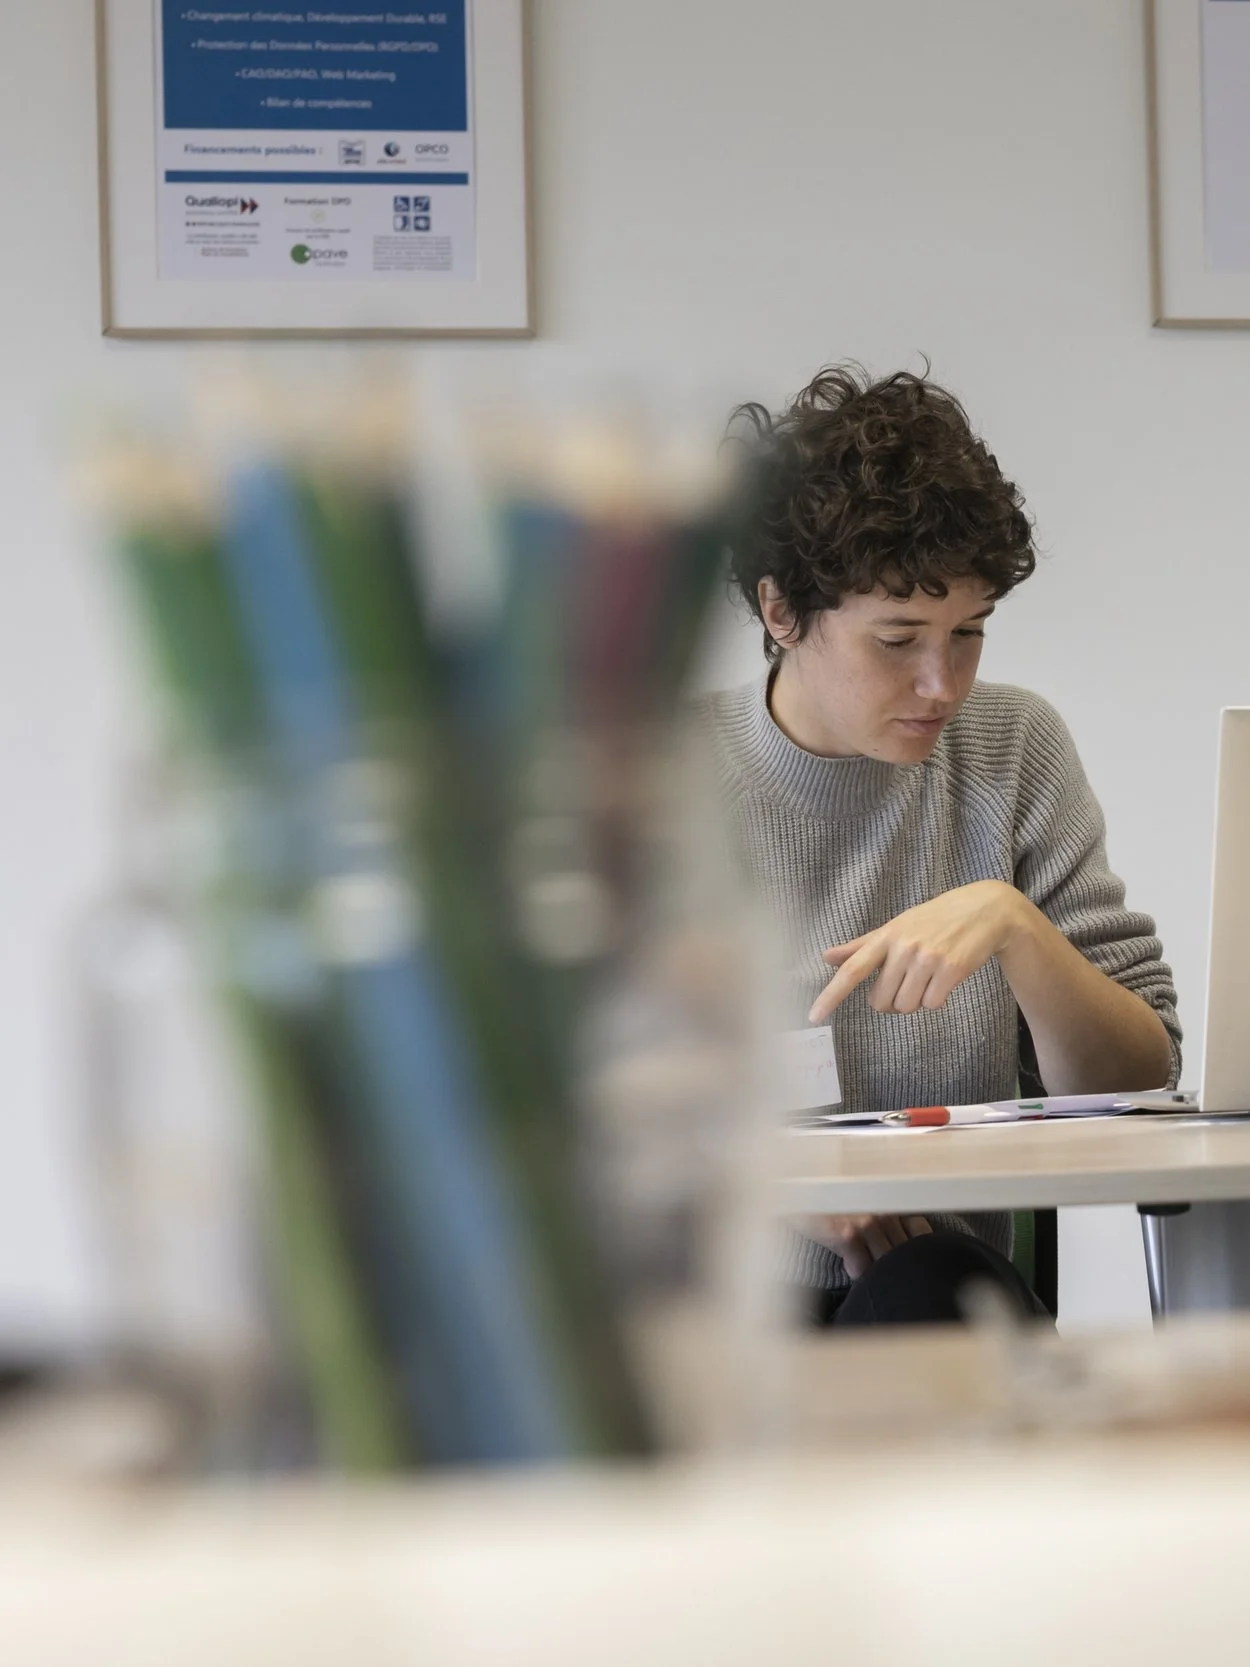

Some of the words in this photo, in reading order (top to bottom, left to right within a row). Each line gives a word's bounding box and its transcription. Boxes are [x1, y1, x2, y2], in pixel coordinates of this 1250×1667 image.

[183, 143, 262, 155] Financements
[263, 144, 317, 157] possibles
[414, 143, 450, 155] OPCO
[184, 195, 239, 208] Qualiopi
[283, 197, 330, 206] Formation
